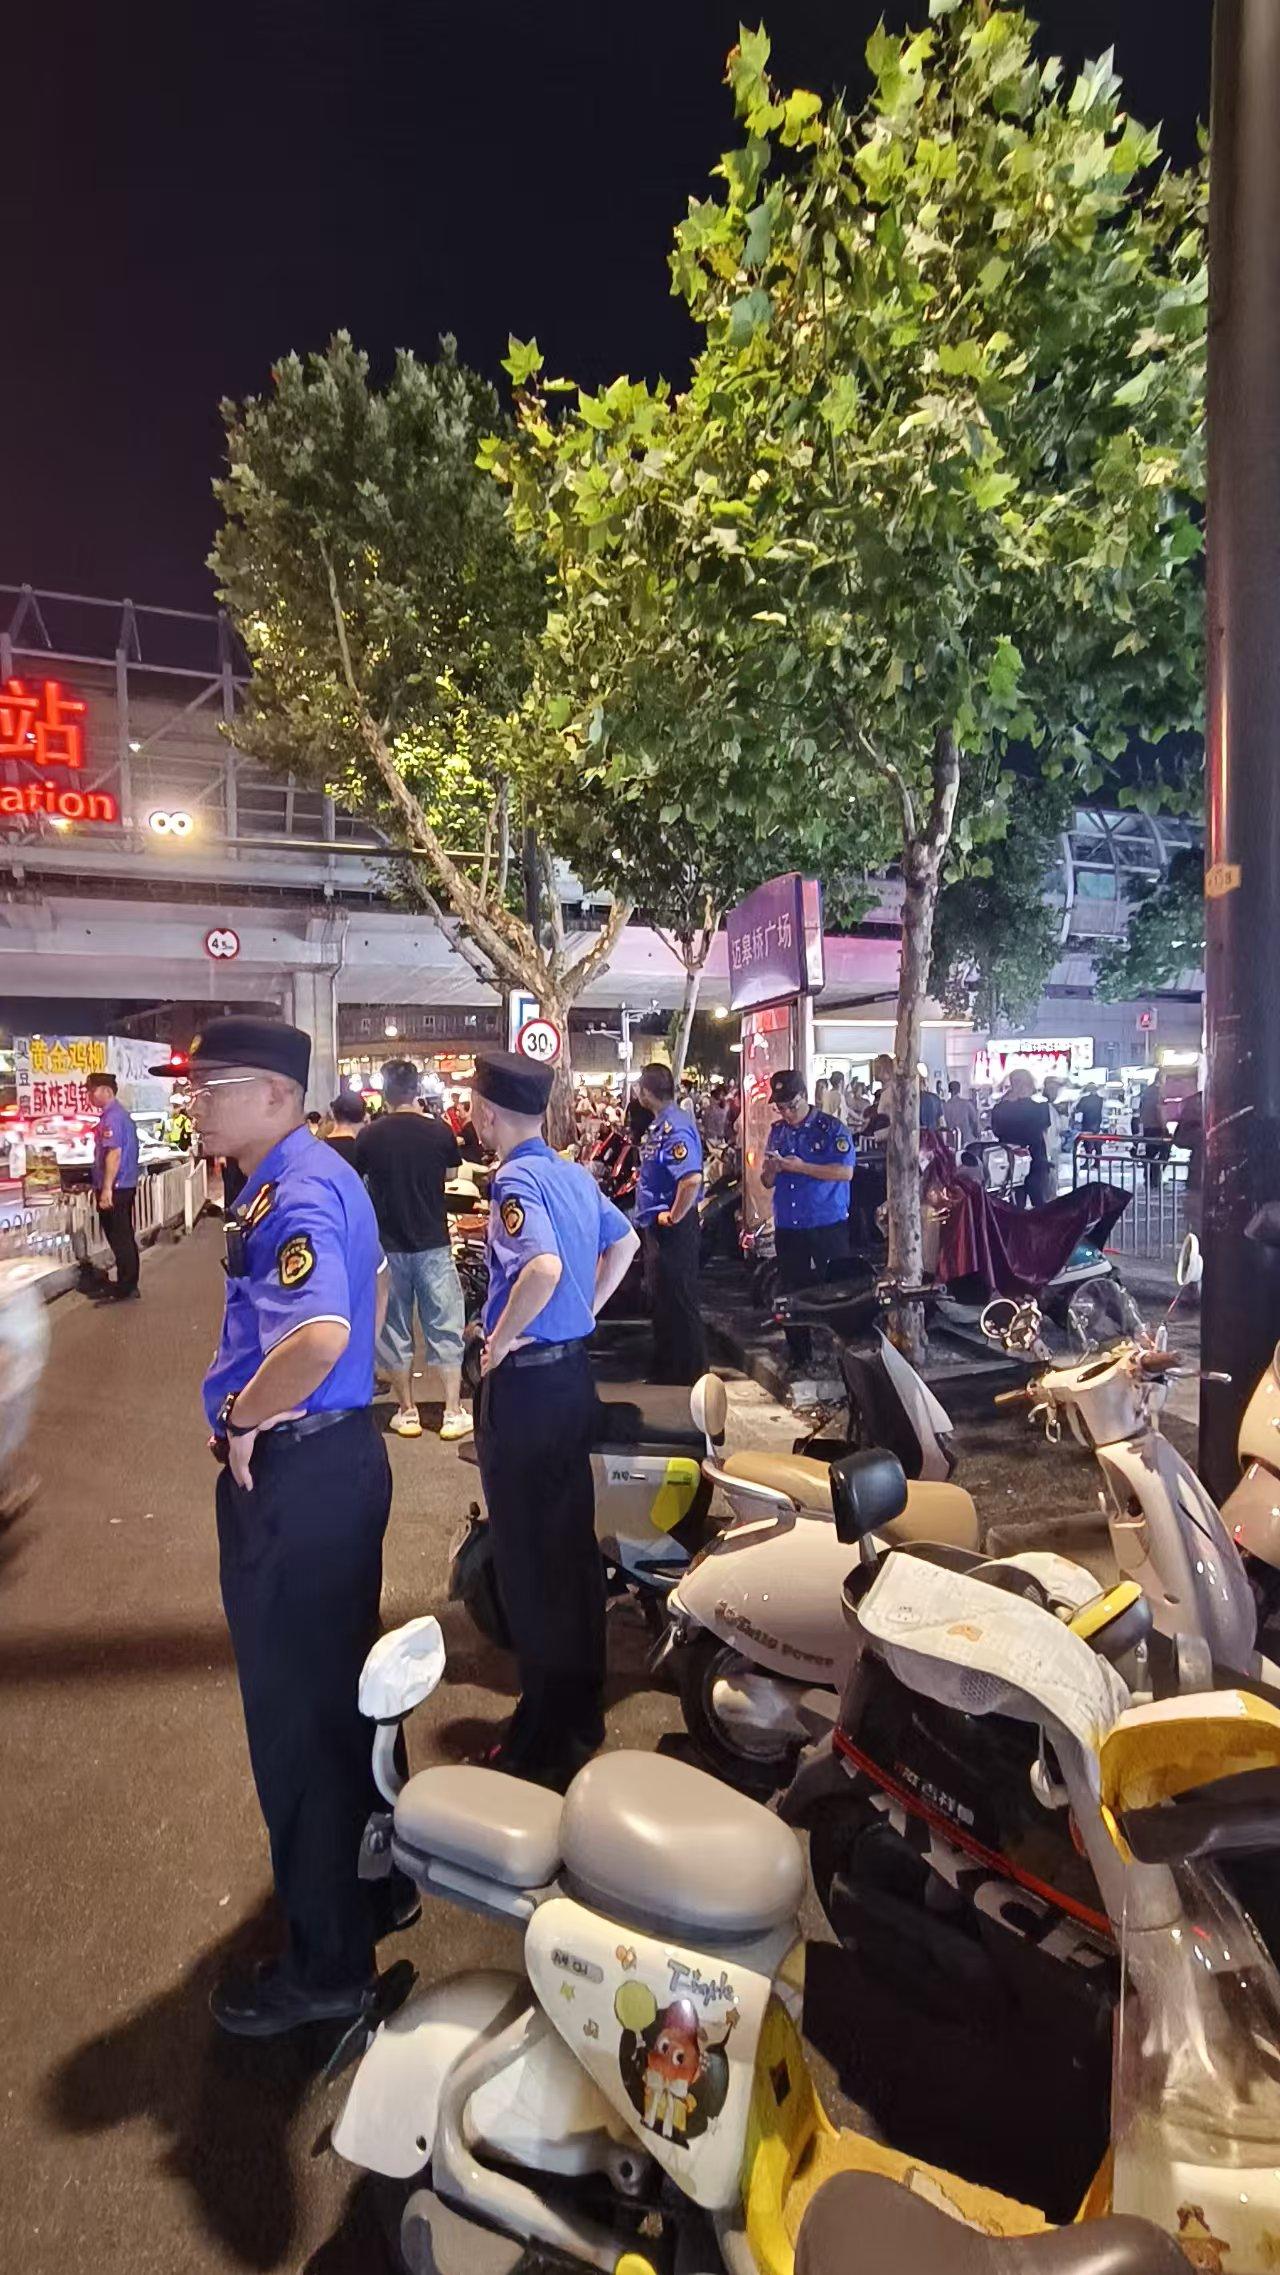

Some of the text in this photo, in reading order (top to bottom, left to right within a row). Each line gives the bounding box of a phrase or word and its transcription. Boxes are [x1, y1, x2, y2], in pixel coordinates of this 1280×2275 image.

[0, 680, 85, 768] 站
[731, 912, 792, 970] 迈皋桥广场
[29, 1038, 107, 1075] 黄金鸡柳
